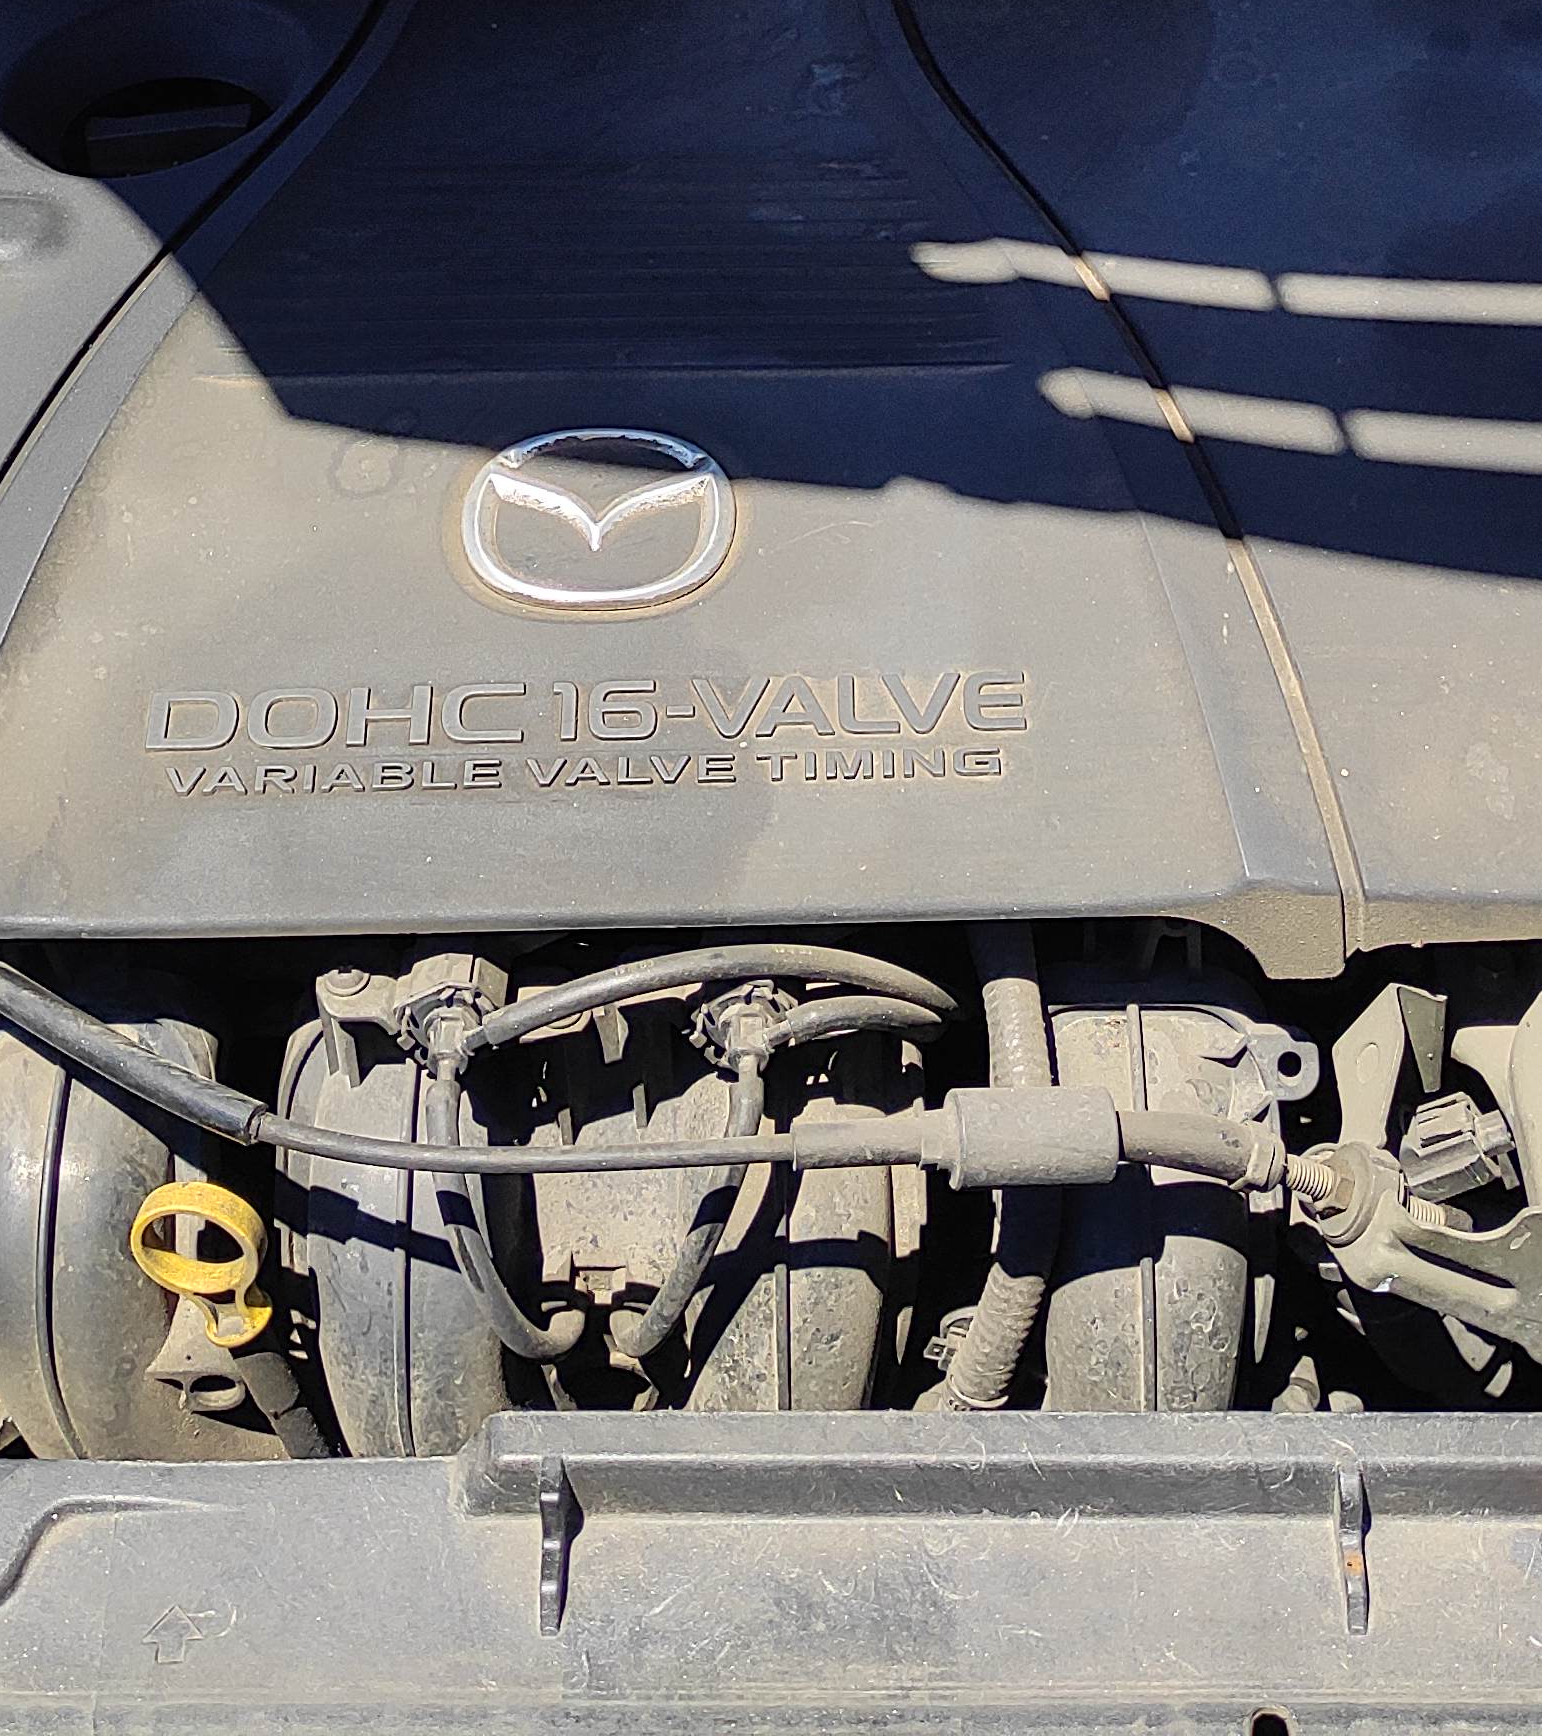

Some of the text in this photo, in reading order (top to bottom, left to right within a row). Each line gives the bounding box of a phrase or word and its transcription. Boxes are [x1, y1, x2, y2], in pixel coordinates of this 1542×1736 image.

[144, 670, 1031, 752] DOHC 16-VALVE
[163, 746, 1005, 797] VARIABLE VALVE TIMING
